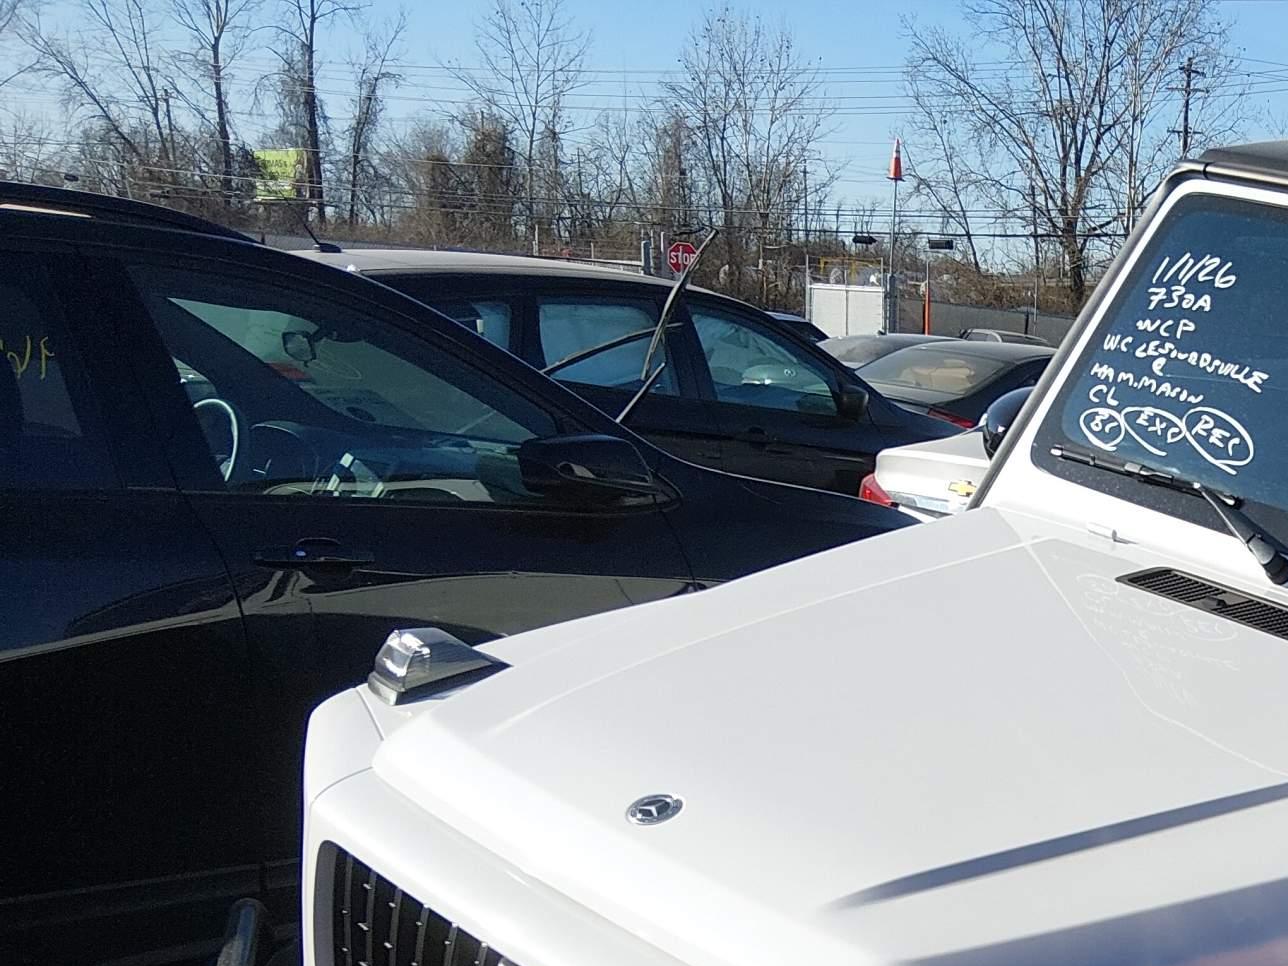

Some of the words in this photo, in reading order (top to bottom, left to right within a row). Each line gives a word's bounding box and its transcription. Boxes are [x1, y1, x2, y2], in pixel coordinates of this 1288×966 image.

[670, 251, 698, 265] STOP
[1152, 252, 1237, 289] 1/1/26
[1136, 319, 1196, 340] WCP
[1089, 384, 1120, 407] CL
